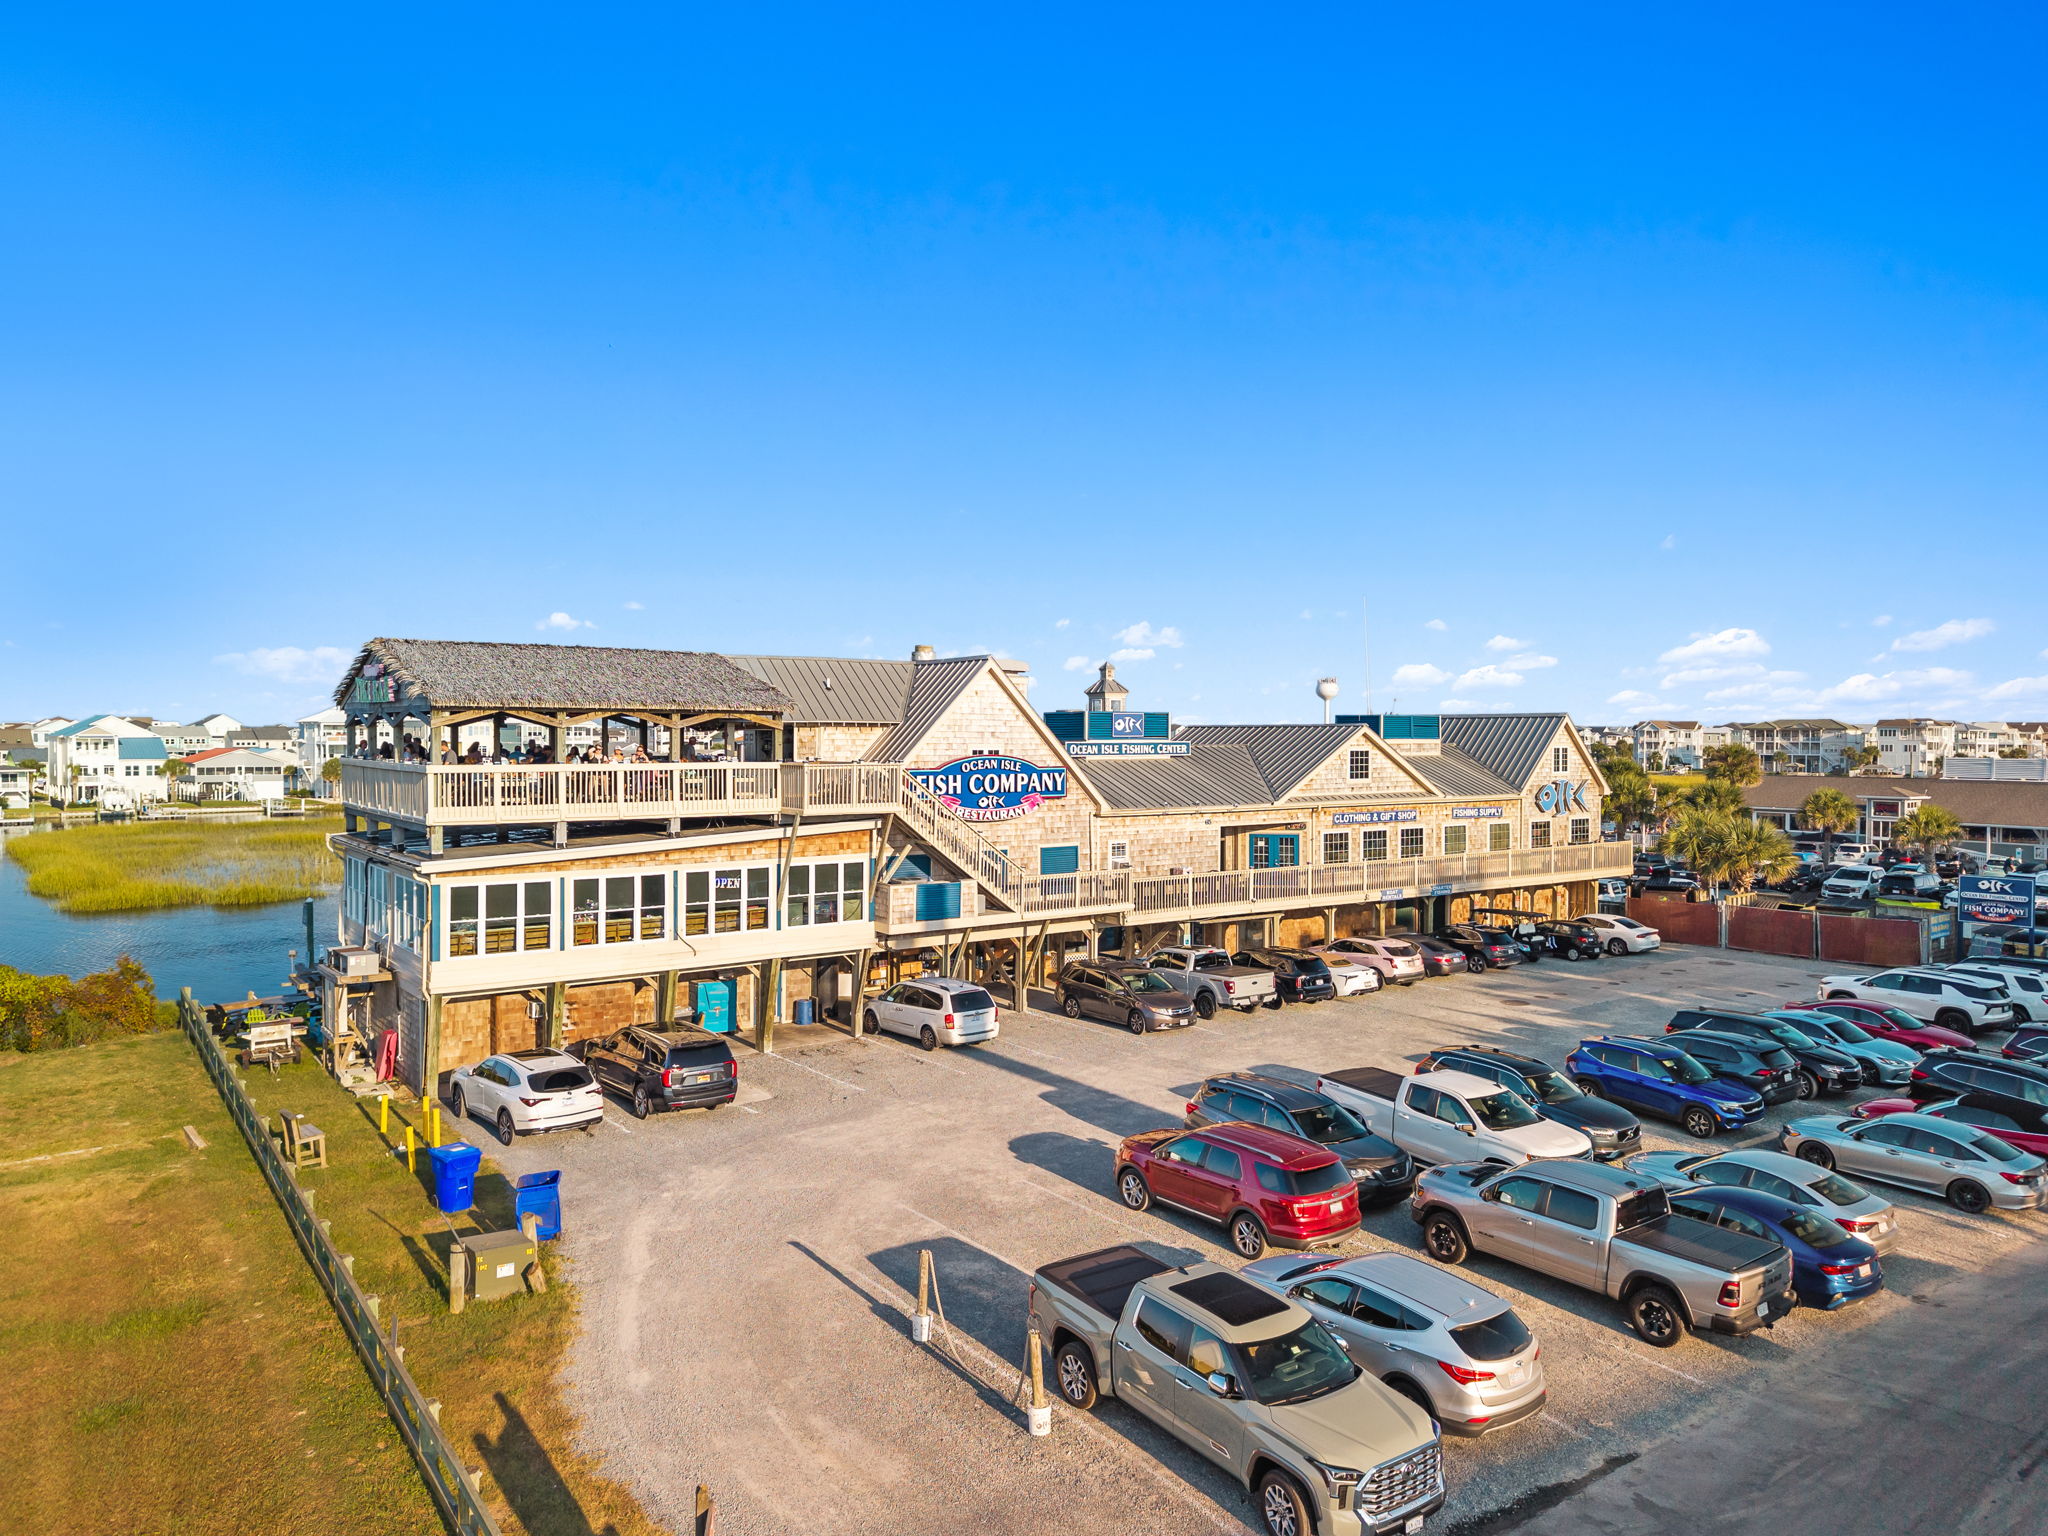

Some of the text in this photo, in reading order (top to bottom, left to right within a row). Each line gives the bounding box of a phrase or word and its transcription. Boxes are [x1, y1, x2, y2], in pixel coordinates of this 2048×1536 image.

[1070, 743, 1187, 755] OCEAN ISLE FISHING CENTER
[961, 759, 1022, 773] OCEAN ISLE
[968, 771, 1066, 794] COMPANY
[955, 806, 1028, 821] RESTAURANT
[1334, 811, 1416, 824] CLOTHING & GIFT SHOP
[1453, 807, 1502, 817] FISHING SUPPLY
[715, 877, 740, 889] OPEN
[1984, 907, 2025, 915] COMPANY
